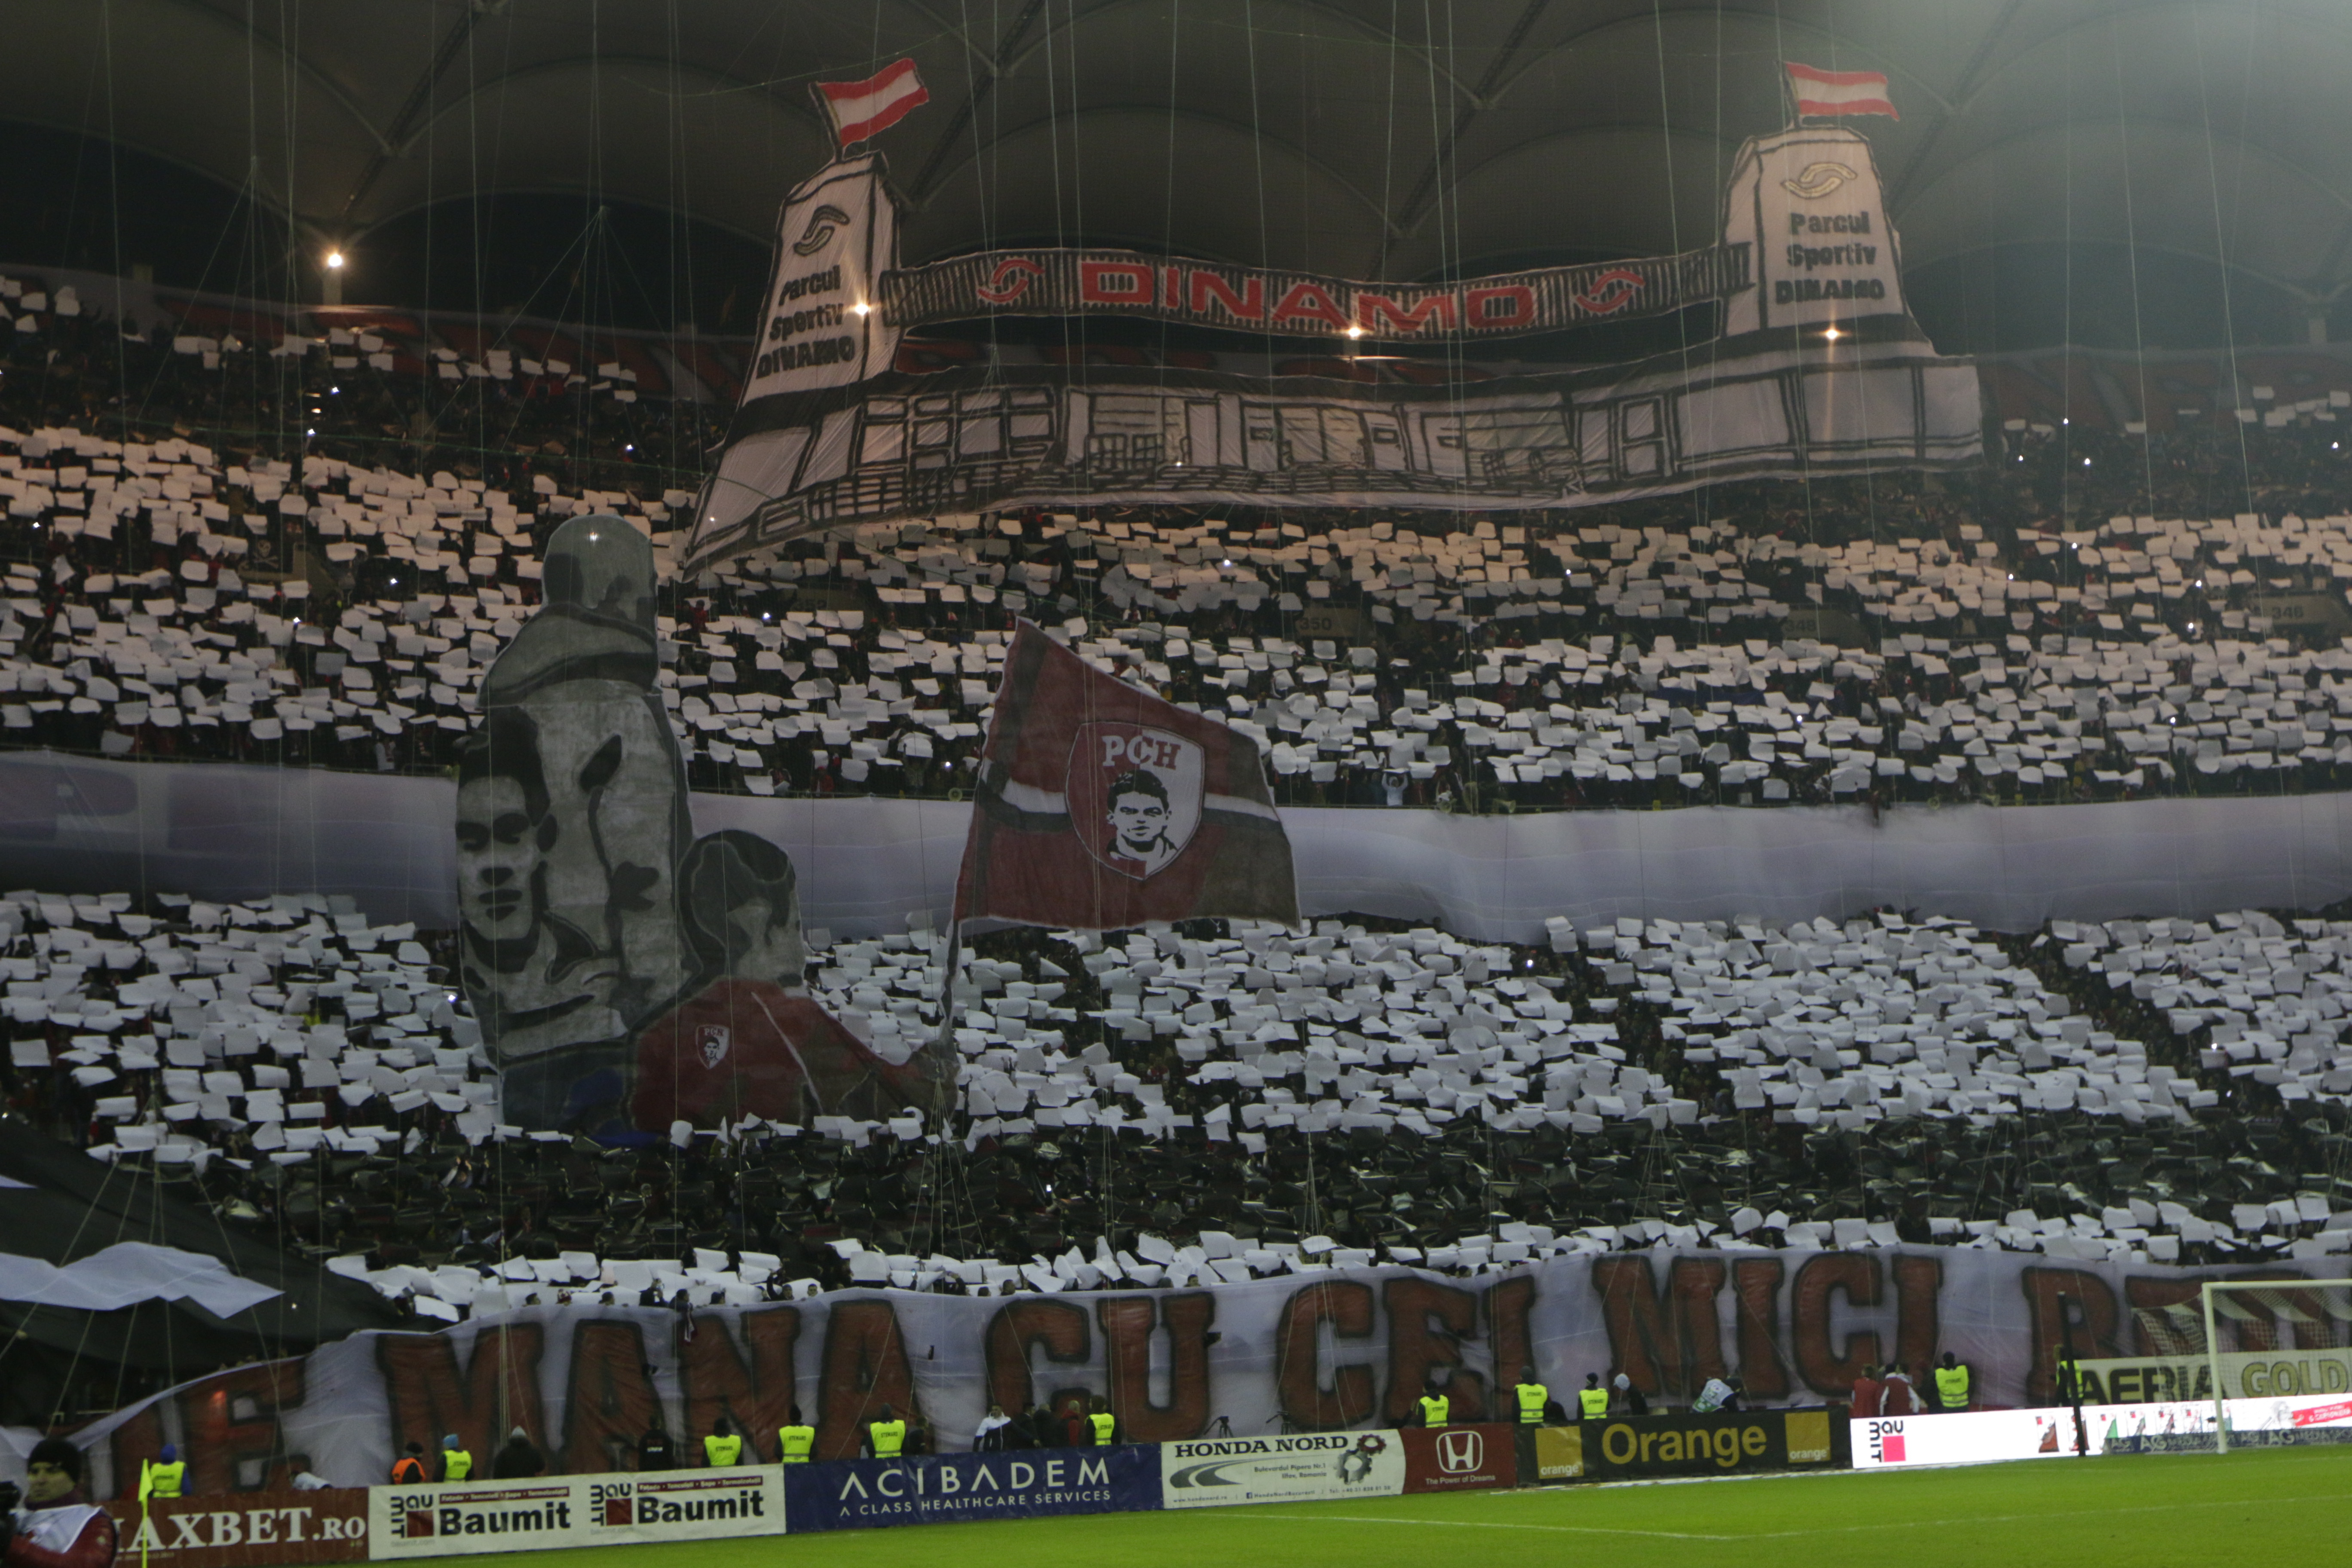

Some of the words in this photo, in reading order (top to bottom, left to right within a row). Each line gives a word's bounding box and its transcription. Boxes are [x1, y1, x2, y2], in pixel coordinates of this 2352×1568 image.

[1789, 211, 1871, 235] Parcul
[1787, 243, 1877, 271] Sportiv
[1081, 262, 1534, 330] DINAMO
[1775, 279, 1885, 305] DINAMO
[1298, 618, 1332, 631] 350
[1102, 735, 1181, 770] PCH
[2242, 1359, 2349, 1397] GOLD
[1175, 1440, 1271, 1458] HONDA
[1276, 1436, 1348, 1452] NORD
[1602, 1423, 1767, 1467] Orange
[1789, 1449, 1827, 1461] orange
[839, 1457, 1110, 1501] ACIBADEM
[1440, 1476, 1461, 1484] Power
[1470, 1474, 1496, 1482] Dreams
[1540, 1463, 1579, 1477] orange
[638, 1490, 764, 1524] Baumit
[860, 1501, 912, 1515] CLASS
[921, 1494, 1026, 1511] HEALTHCARE
[1035, 1490, 1111, 1504] SERVICES
[112, 1507, 367, 1553] AXBET.RO
[439, 1501, 570, 1536] Baumit
